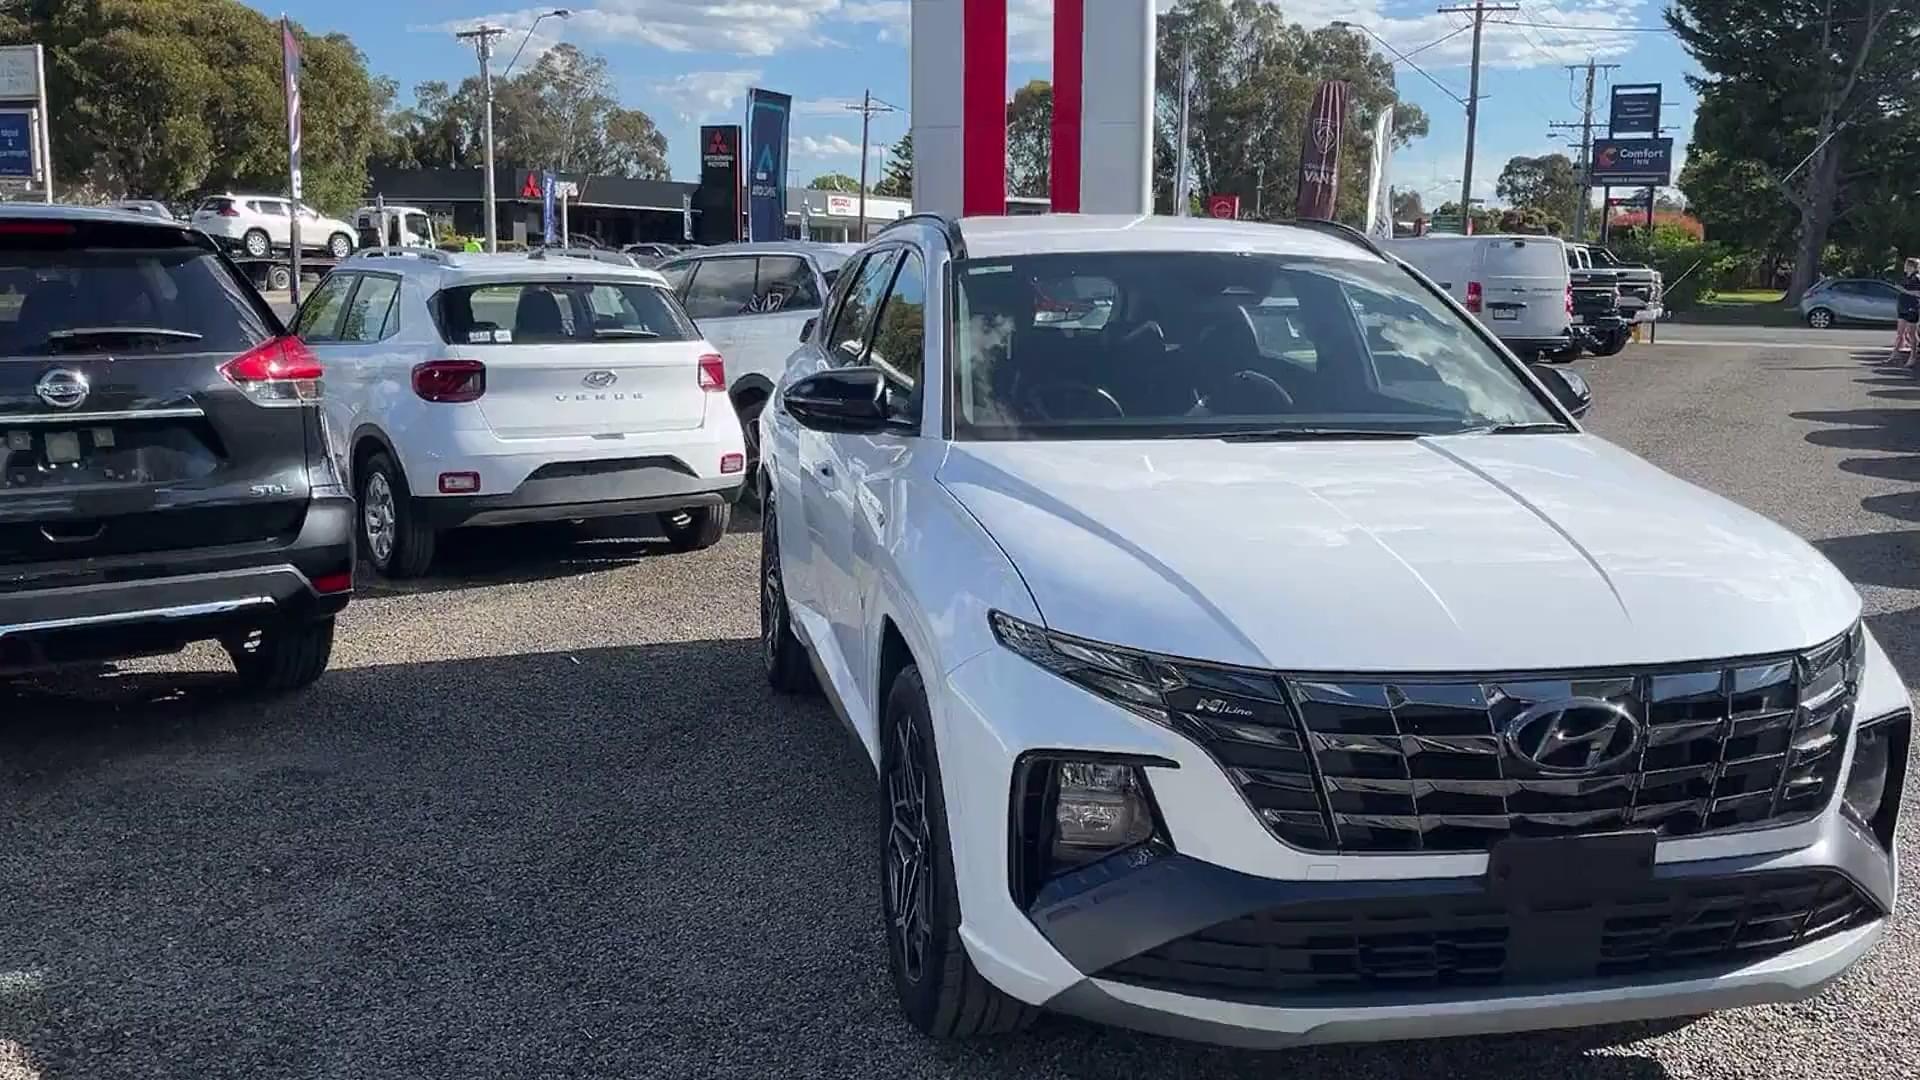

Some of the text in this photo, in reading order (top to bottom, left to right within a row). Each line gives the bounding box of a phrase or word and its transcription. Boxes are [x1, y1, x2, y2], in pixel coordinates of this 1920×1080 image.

[1620, 148, 1664, 159] Comfort
[1303, 170, 1337, 186] VANS
[555, 391, 644, 402] VENUE
[1225, 706, 1253, 717] Line
